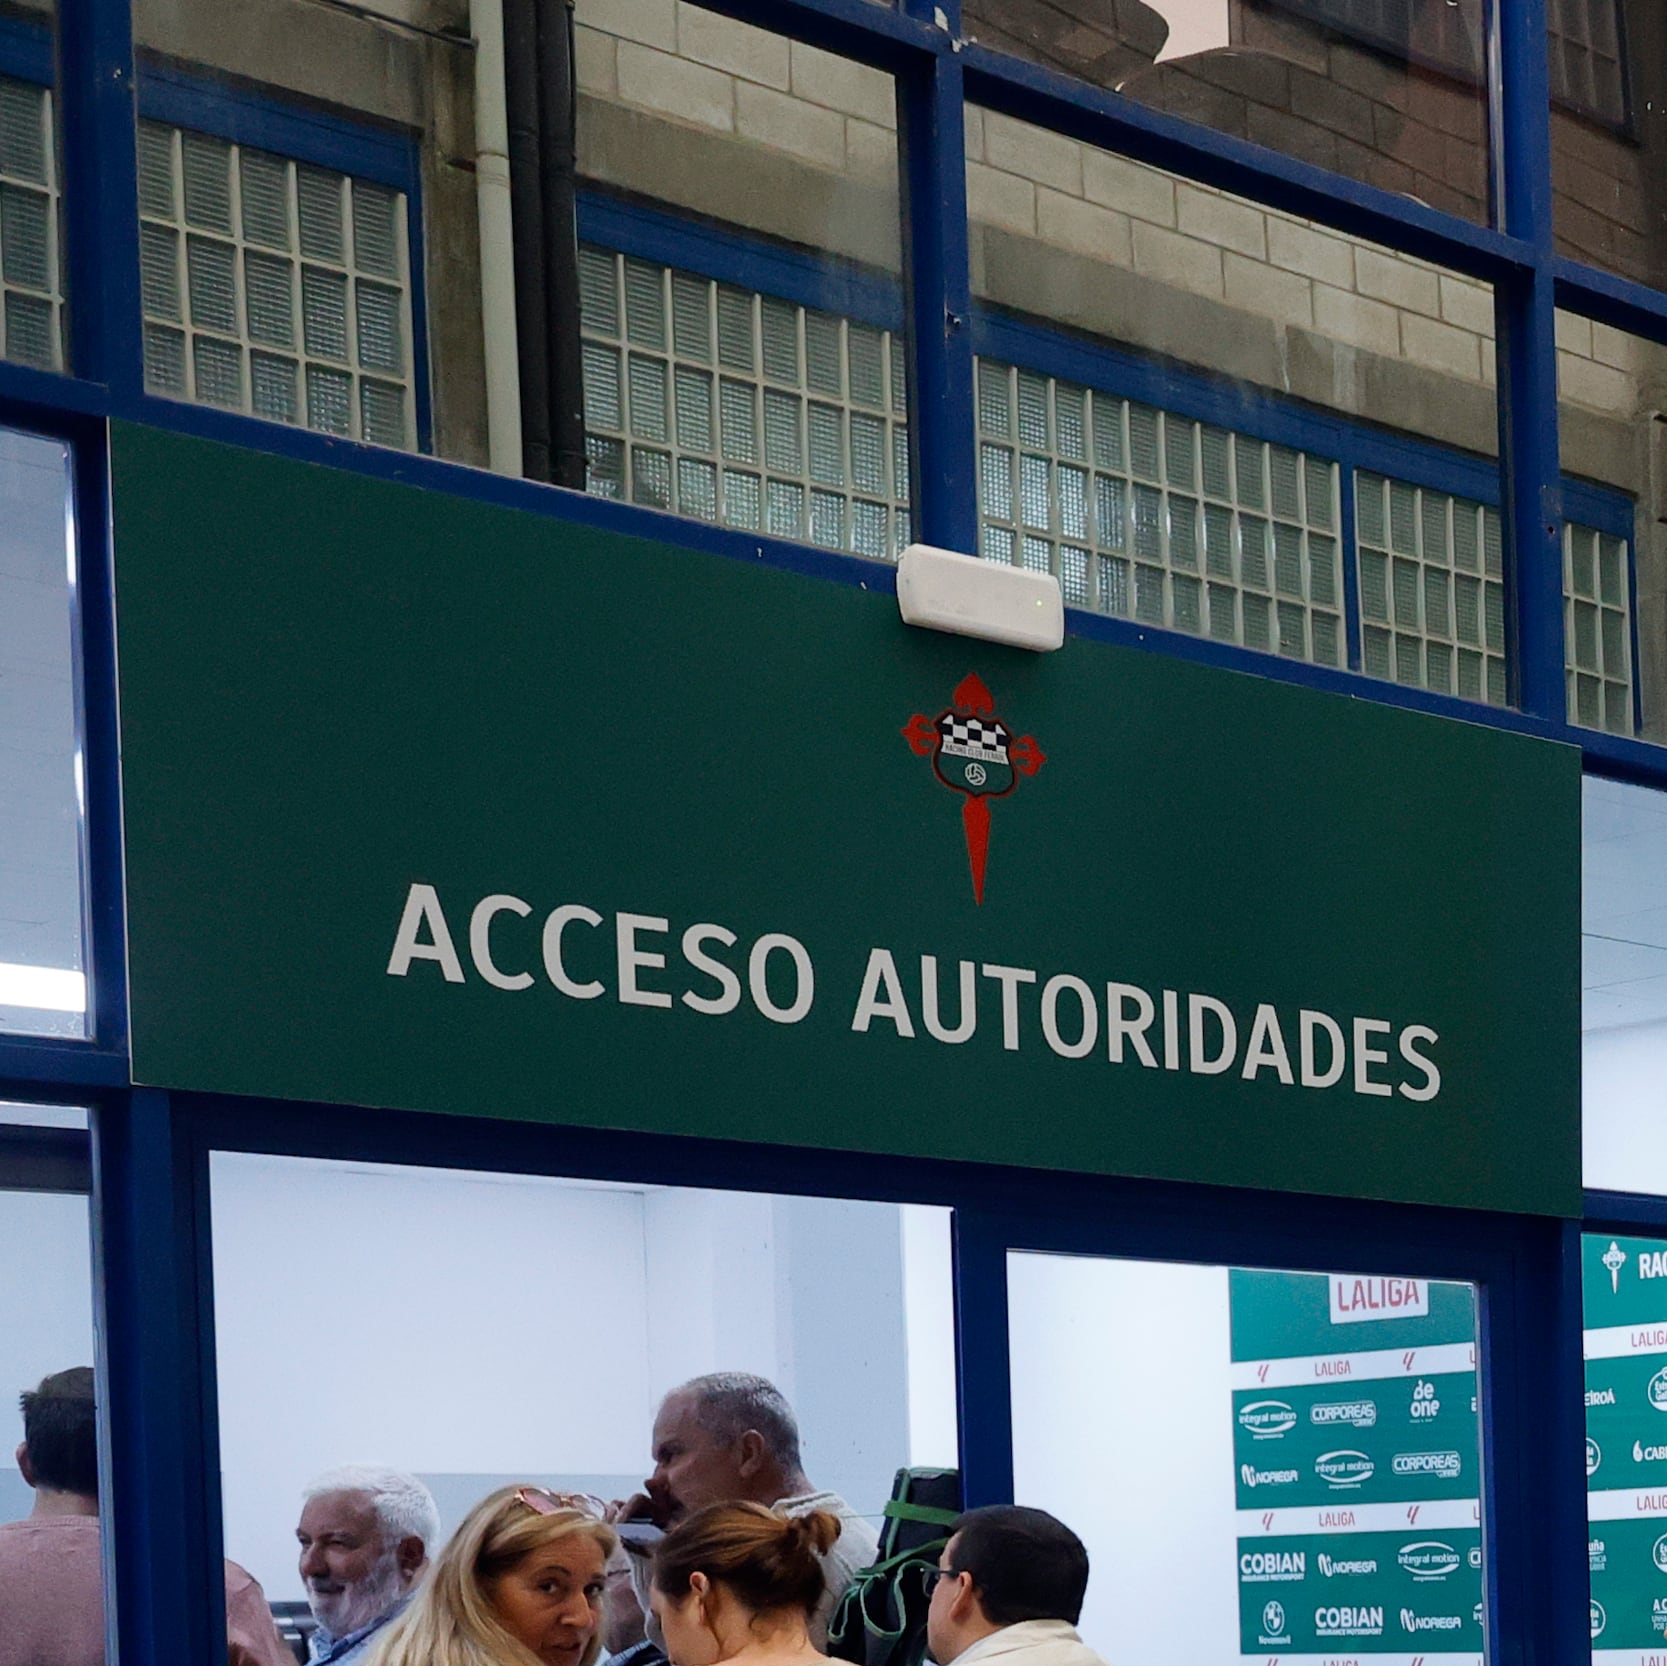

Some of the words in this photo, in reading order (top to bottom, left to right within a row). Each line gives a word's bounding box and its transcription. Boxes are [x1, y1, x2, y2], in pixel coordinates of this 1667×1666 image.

[386, 882, 816, 1025] ACCESO
[851, 947, 1442, 1103] AUTORIDADES
[1338, 1279, 1420, 1312] LALIGA
[1314, 1360, 1352, 1377] LALIGA
[1584, 1388, 1616, 1407] EIROÁ
[1311, 1404, 1375, 1421] CORPOREAS
[1393, 1455, 1459, 1471] CORPOREAS
[1256, 1470, 1299, 1485] NORIEGA
[1318, 1511, 1356, 1528] LALIGA
[1240, 1552, 1306, 1574] COBIAN
[1332, 1560, 1377, 1574] NORIEGA
[1398, 1553, 1430, 1567] integral
[1431, 1552, 1460, 1564] motion
[1315, 1606, 1384, 1628] COBIAN
[1415, 1616, 1462, 1630] NORIEGA
